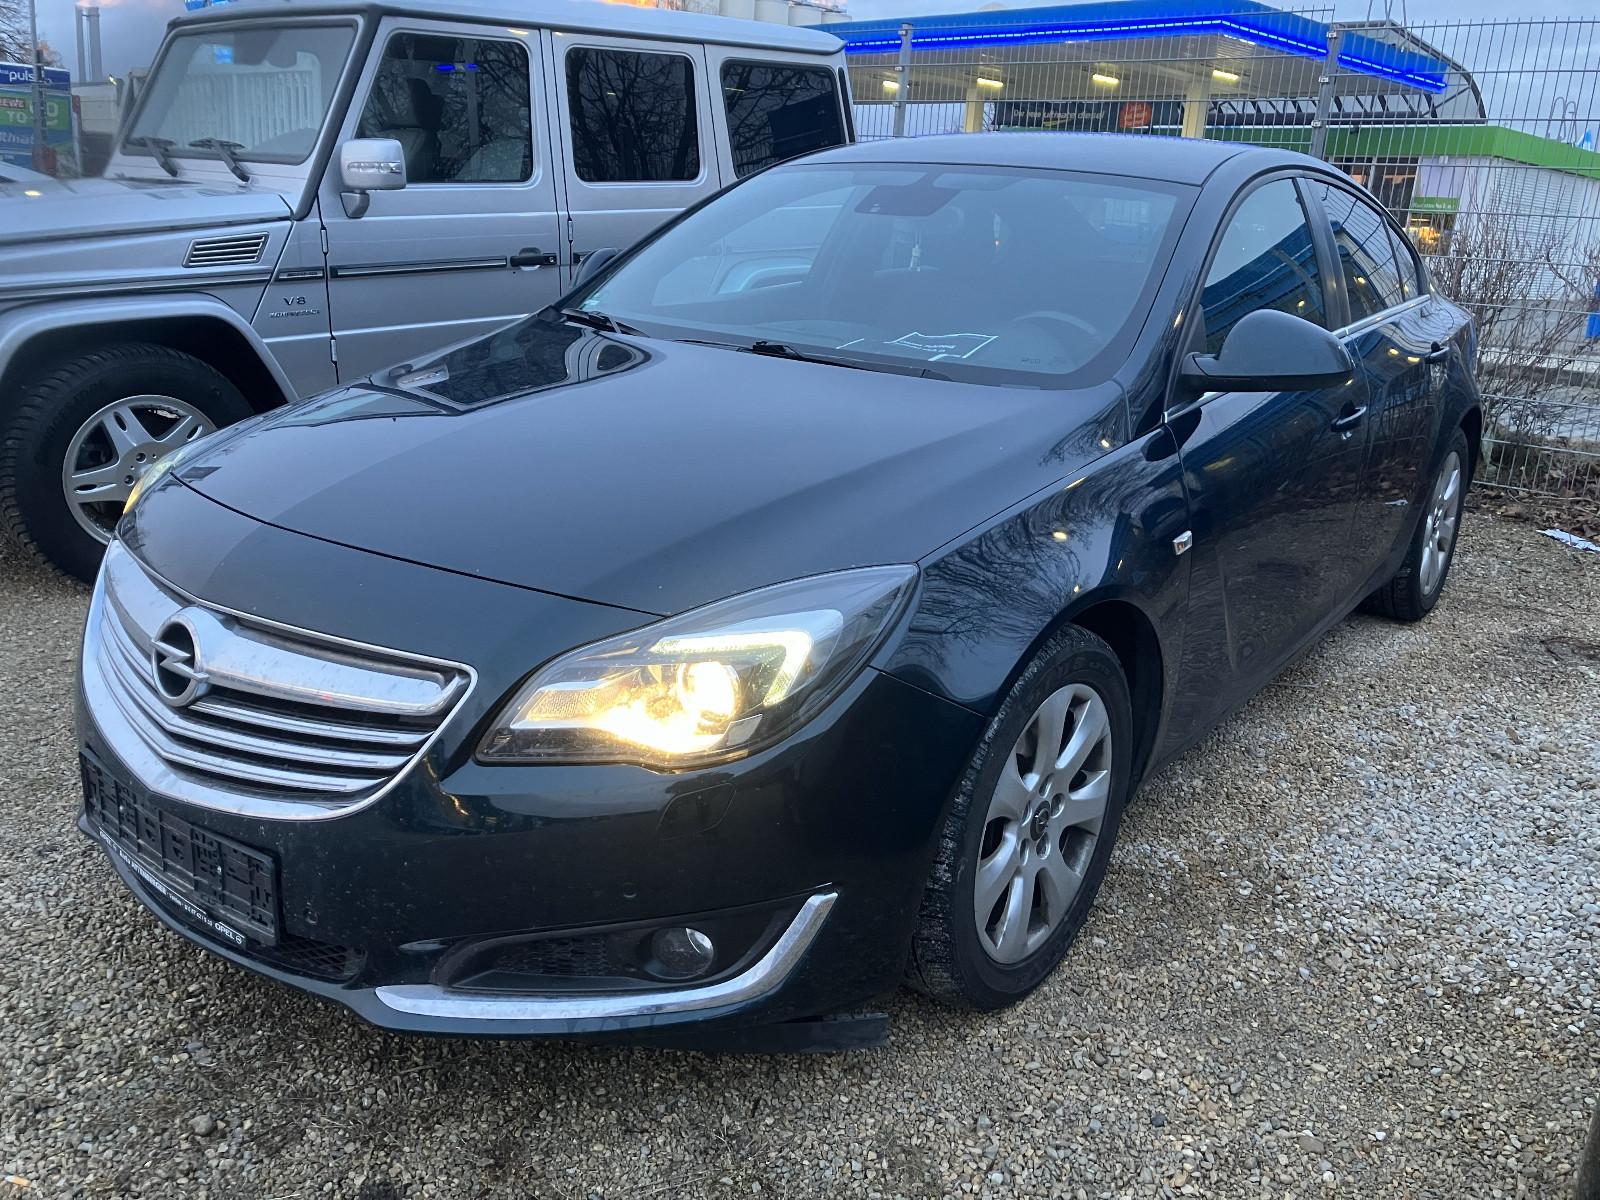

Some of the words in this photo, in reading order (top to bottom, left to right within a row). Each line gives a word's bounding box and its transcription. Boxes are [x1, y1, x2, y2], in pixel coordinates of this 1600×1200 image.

[9, 70, 36, 83] puls
[283, 296, 306, 306] V8
[214, 922, 235, 940] OPEL
